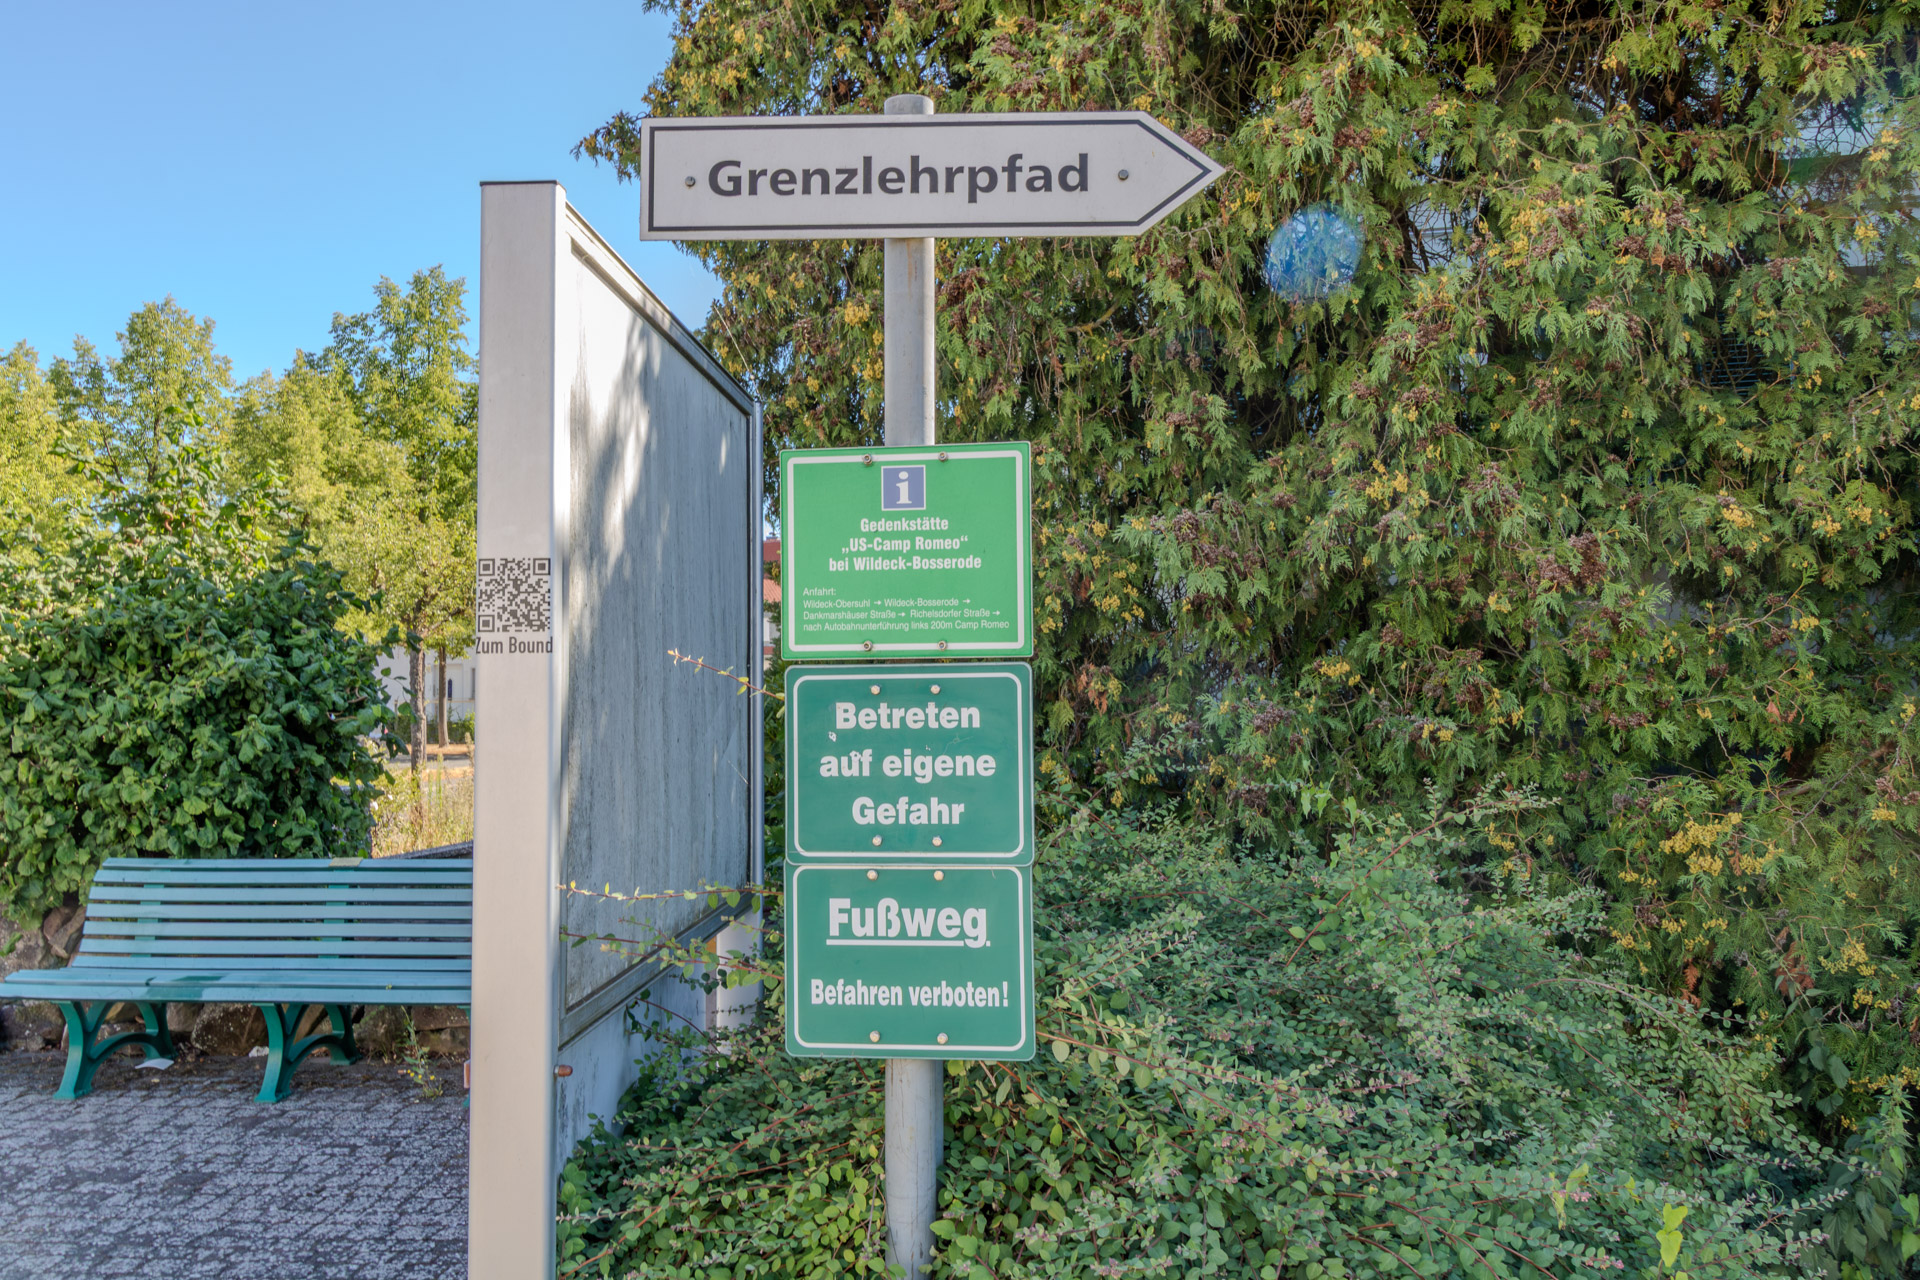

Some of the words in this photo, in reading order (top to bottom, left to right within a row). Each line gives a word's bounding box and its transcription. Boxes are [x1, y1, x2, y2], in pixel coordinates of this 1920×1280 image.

[707, 152, 1090, 205] Grenzlehrpfad
[860, 516, 949, 532] Gedenkstätte
[829, 557, 849, 571] bei
[853, 555, 982, 571] Wildeck-Bosserode
[803, 587, 836, 596] Anfahrt:
[803, 599, 871, 609] Wildeck-Obersuhl
[884, 597, 959, 607] Wildeck-Bosserode
[803, 611, 868, 620] Dankmarshäuser
[870, 610, 896, 619] Straße
[910, 609, 962, 618] Richelsdorfer
[963, 608, 990, 617] Straße
[803, 622, 822, 631] nach
[824, 621, 909, 632] Autobahnunterführung
[911, 621, 928, 630] links
[930, 620, 953, 630] 200m
[954, 620, 979, 631] Camp
[980, 619, 1010, 629] Romeo
[476, 637, 503, 654] Zum
[508, 636, 553, 654] Bound
[835, 702, 980, 730] Betreten
[819, 749, 873, 777] auf
[882, 748, 997, 784] eigene
[852, 796, 965, 825] Gefahr
[811, 979, 902, 1006] Befahren
[908, 980, 1009, 1008] verboten!
